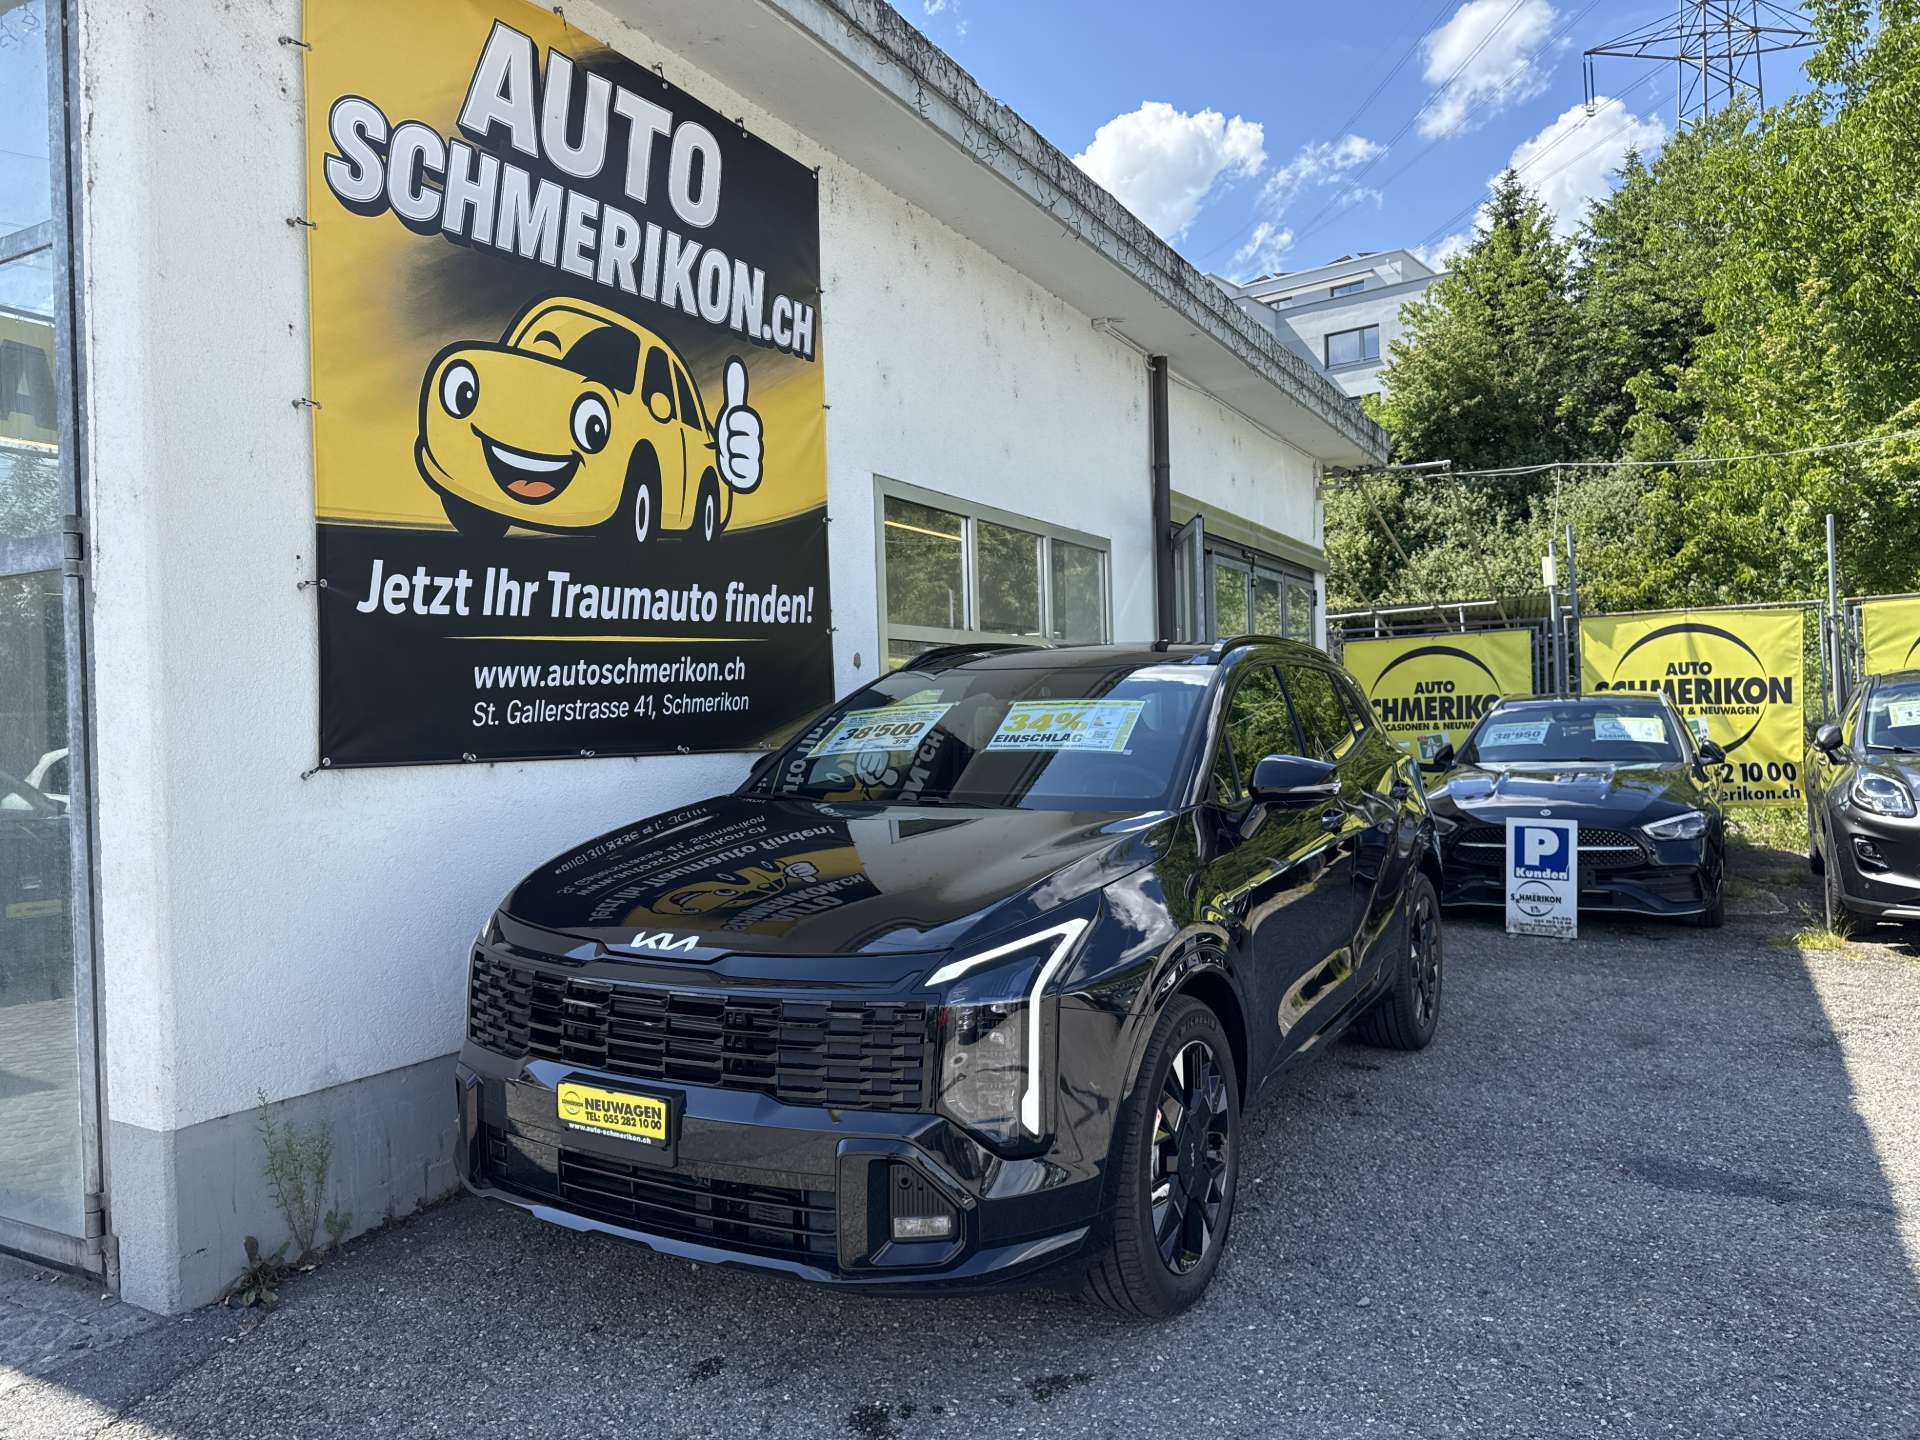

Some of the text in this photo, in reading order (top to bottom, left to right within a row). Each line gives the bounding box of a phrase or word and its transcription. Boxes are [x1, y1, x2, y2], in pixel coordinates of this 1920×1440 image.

[460, 20, 722, 228] AUTO
[326, 99, 815, 356] SCHMERIKON.CH
[357, 559, 814, 624] Jetzt Ihr Traumauto finden!
[474, 656, 746, 689] www.autoschmerikon.ch
[1665, 661, 1713, 676] AUTO
[1414, 680, 1456, 695] AUTO
[472, 692, 750, 727] St. Gallerstrasse 41, Schmerikon
[1700, 705, 1760, 716] NEUWAGEN
[839, 721, 925, 741] 38'500
[1003, 711, 1088, 733] 34%
[1433, 722, 1440, 731] &
[993, 733, 1083, 744] EINSCHLAG
[1740, 763, 1763, 783] 10
[1768, 762, 1797, 782] 00
[1524, 827, 1560, 866] P
[1515, 867, 1568, 880] Kunden
[584, 1097, 662, 1120] NEUWAGEN
[585, 1110, 661, 1130] TEL: 055 282 10 00
[568, 1123, 652, 1144] www.auto-schmerikon.ch
